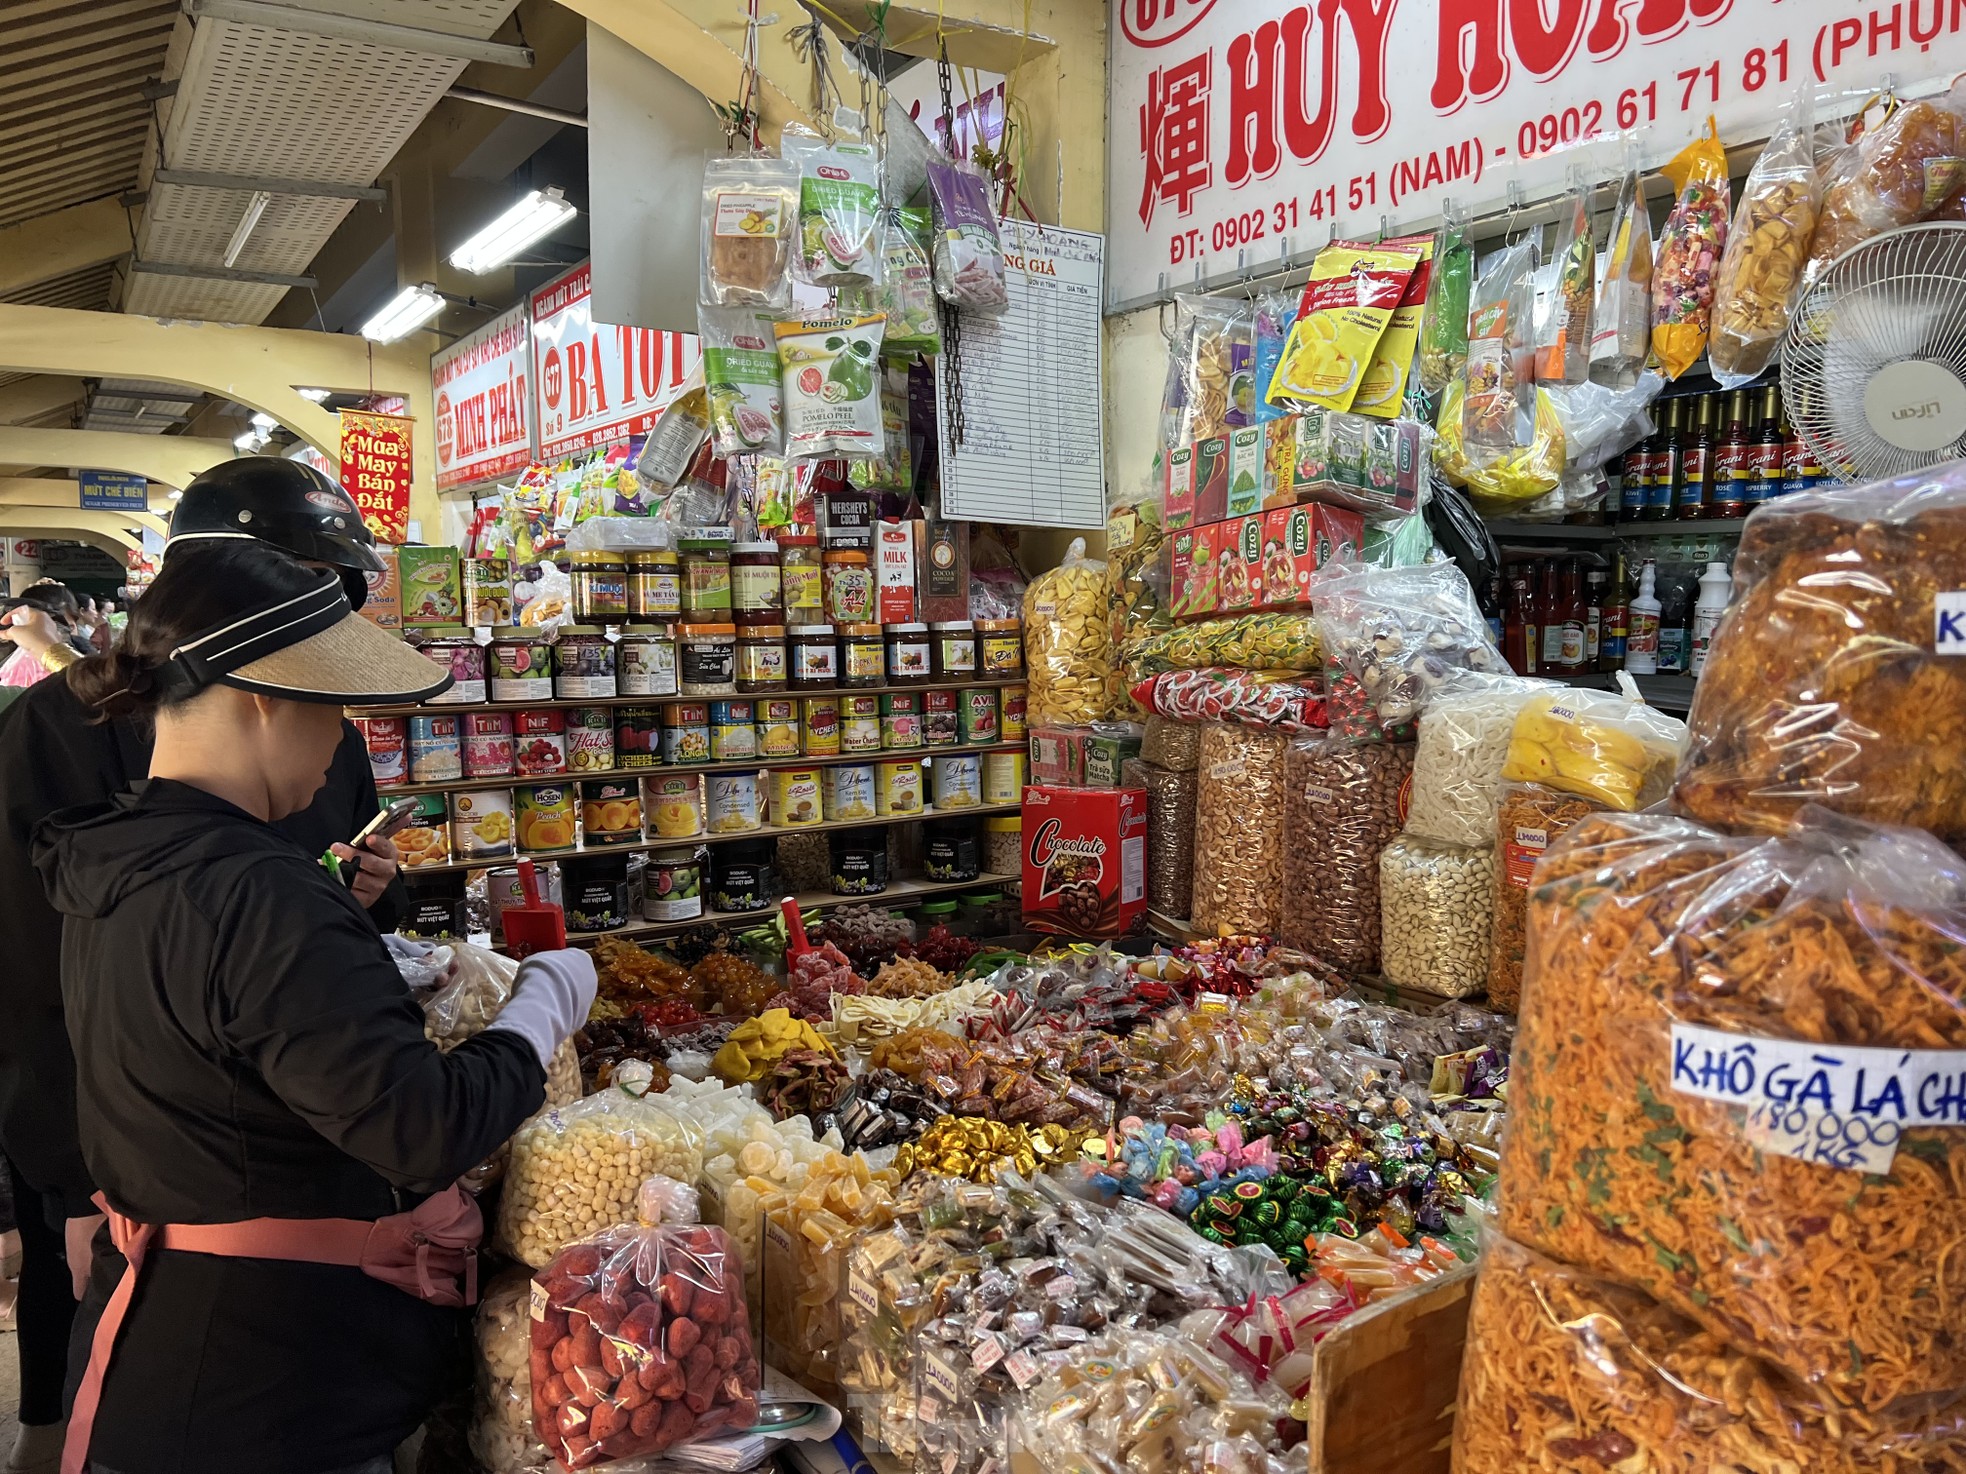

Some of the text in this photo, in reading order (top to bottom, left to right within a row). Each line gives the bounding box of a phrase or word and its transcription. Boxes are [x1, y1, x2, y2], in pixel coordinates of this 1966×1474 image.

[1225, 0, 1399, 189] HUY
[1170, 228, 1204, 264] ĐT:
[1212, 213, 1265, 252] 0902
[1273, 197, 1298, 233] 31
[1309, 185, 1336, 220] 41
[1348, 172, 1377, 211] 51
[1389, 136, 1484, 207] (NAM)
[1517, 100, 1602, 160] 0902
[1616, 81, 1657, 130] 61
[1677, 60, 1721, 111] 71
[1742, 38, 1789, 92] 81
[1004, 254, 1025, 269] NG
[802, 318, 852, 329] Pomelo
[544, 363, 560, 398] 677
[566, 332, 608, 422] BA
[454, 359, 526, 458] MINH PHÁT
[437, 416, 452, 443] 678
[556, 413, 563, 433] 9
[357, 435, 399, 456] Mua
[1236, 433, 1256, 445] Cozy
[1205, 441, 1224, 453] Cozy
[1171, 450, 1190, 462] Cozy
[1715, 452, 1744, 467] Torani
[1747, 451, 1776, 465] Torani
[357, 454, 397, 476] May
[357, 473, 396, 492] Bán
[1783, 482, 1804, 490] GUAVA
[357, 492, 394, 511] Đắt
[831, 502, 868, 515] HERSHEY'S
[840, 515, 860, 525] COCOA
[1293, 514, 1305, 556] Cozy
[1248, 524, 1258, 562] Cozy
[883, 551, 907, 563] MILK
[975, 708, 986, 716] 50
[911, 725, 919, 734] 50
[844, 737, 862, 745] Water
[1093, 749, 1108, 760] Cozy
[1089, 771, 1110, 781] Matcha
[537, 793, 562, 803] HOSEN
[536, 811, 561, 820] Peach
[1030, 818, 1107, 867] Chocolate
[1675, 1037, 1757, 1096] KHÔ
[1763, 1053, 1844, 1110] GÀ
[1852, 1052, 1911, 1120] LÁ
